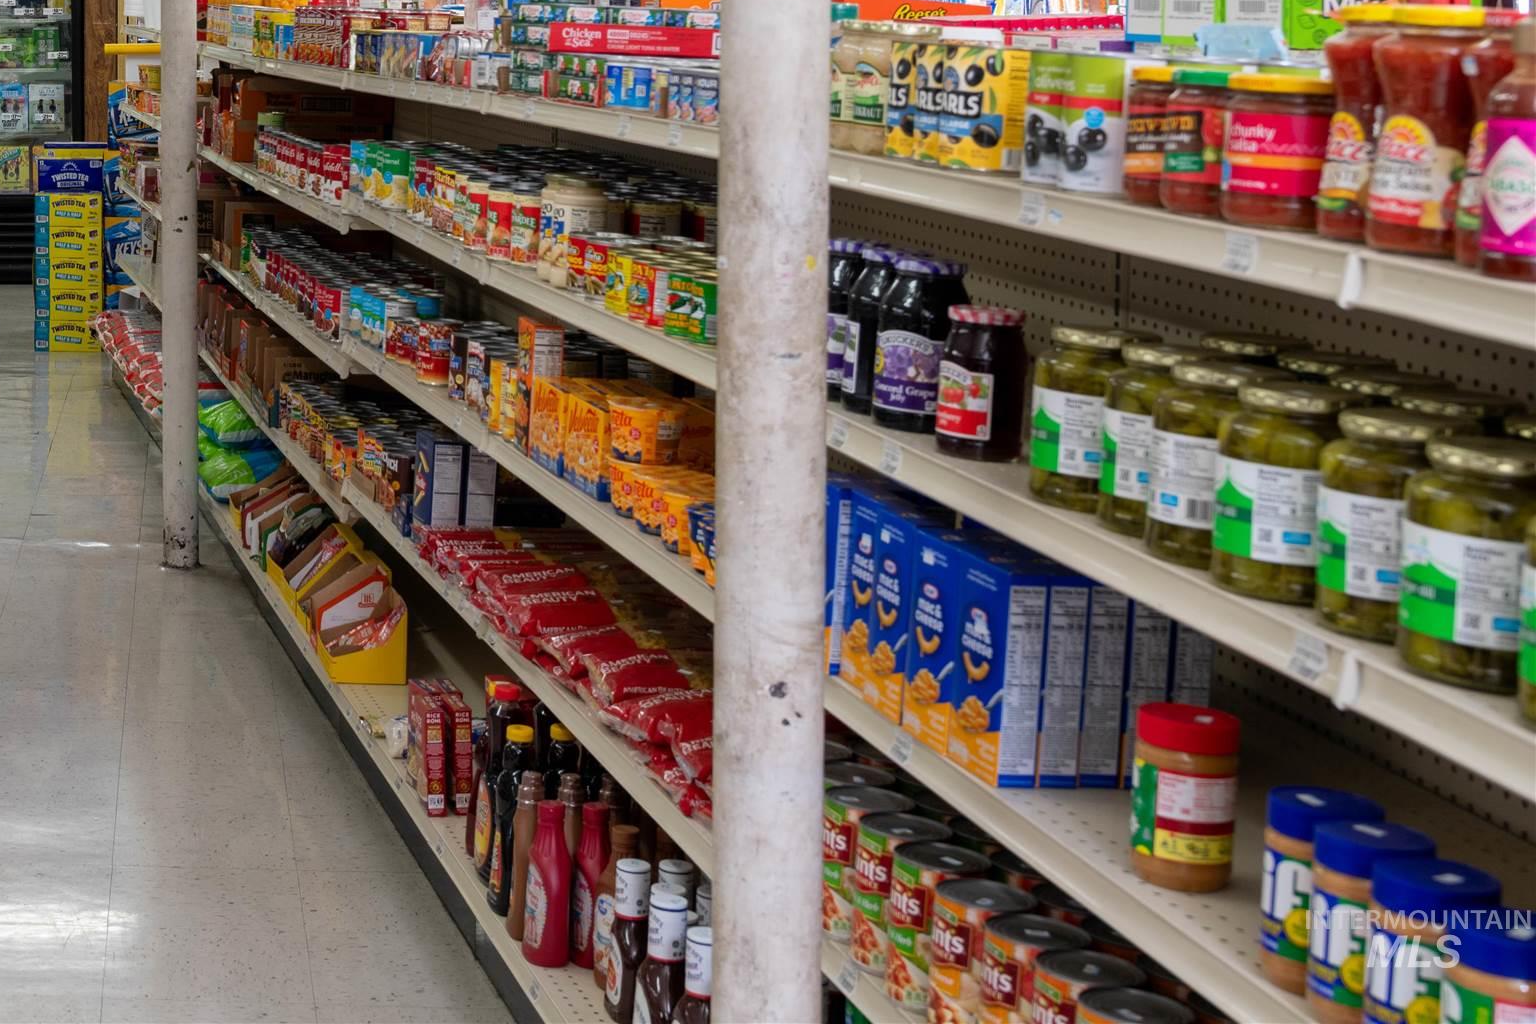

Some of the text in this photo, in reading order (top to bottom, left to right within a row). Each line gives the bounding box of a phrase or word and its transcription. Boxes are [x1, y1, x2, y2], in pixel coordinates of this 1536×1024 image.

[893, 4, 947, 20] Reese's
[562, 27, 602, 40] Chicken
[572, 38, 591, 48] Sea
[50, 172, 89, 182] TWISTED TEA
[51, 199, 86, 208] TWISTED TEA
[51, 231, 86, 240] TWISTED TEA
[51, 262, 86, 271] TWISTED TEA
[51, 293, 86, 302] TWISTED TEA
[51, 325, 86, 334] TWISTED TEA
[905, 384, 936, 399] Grape
[567, 402, 600, 432] Velveeta
[502, 566, 575, 584] AMERICAN
[520, 589, 596, 605] AMERICAN
